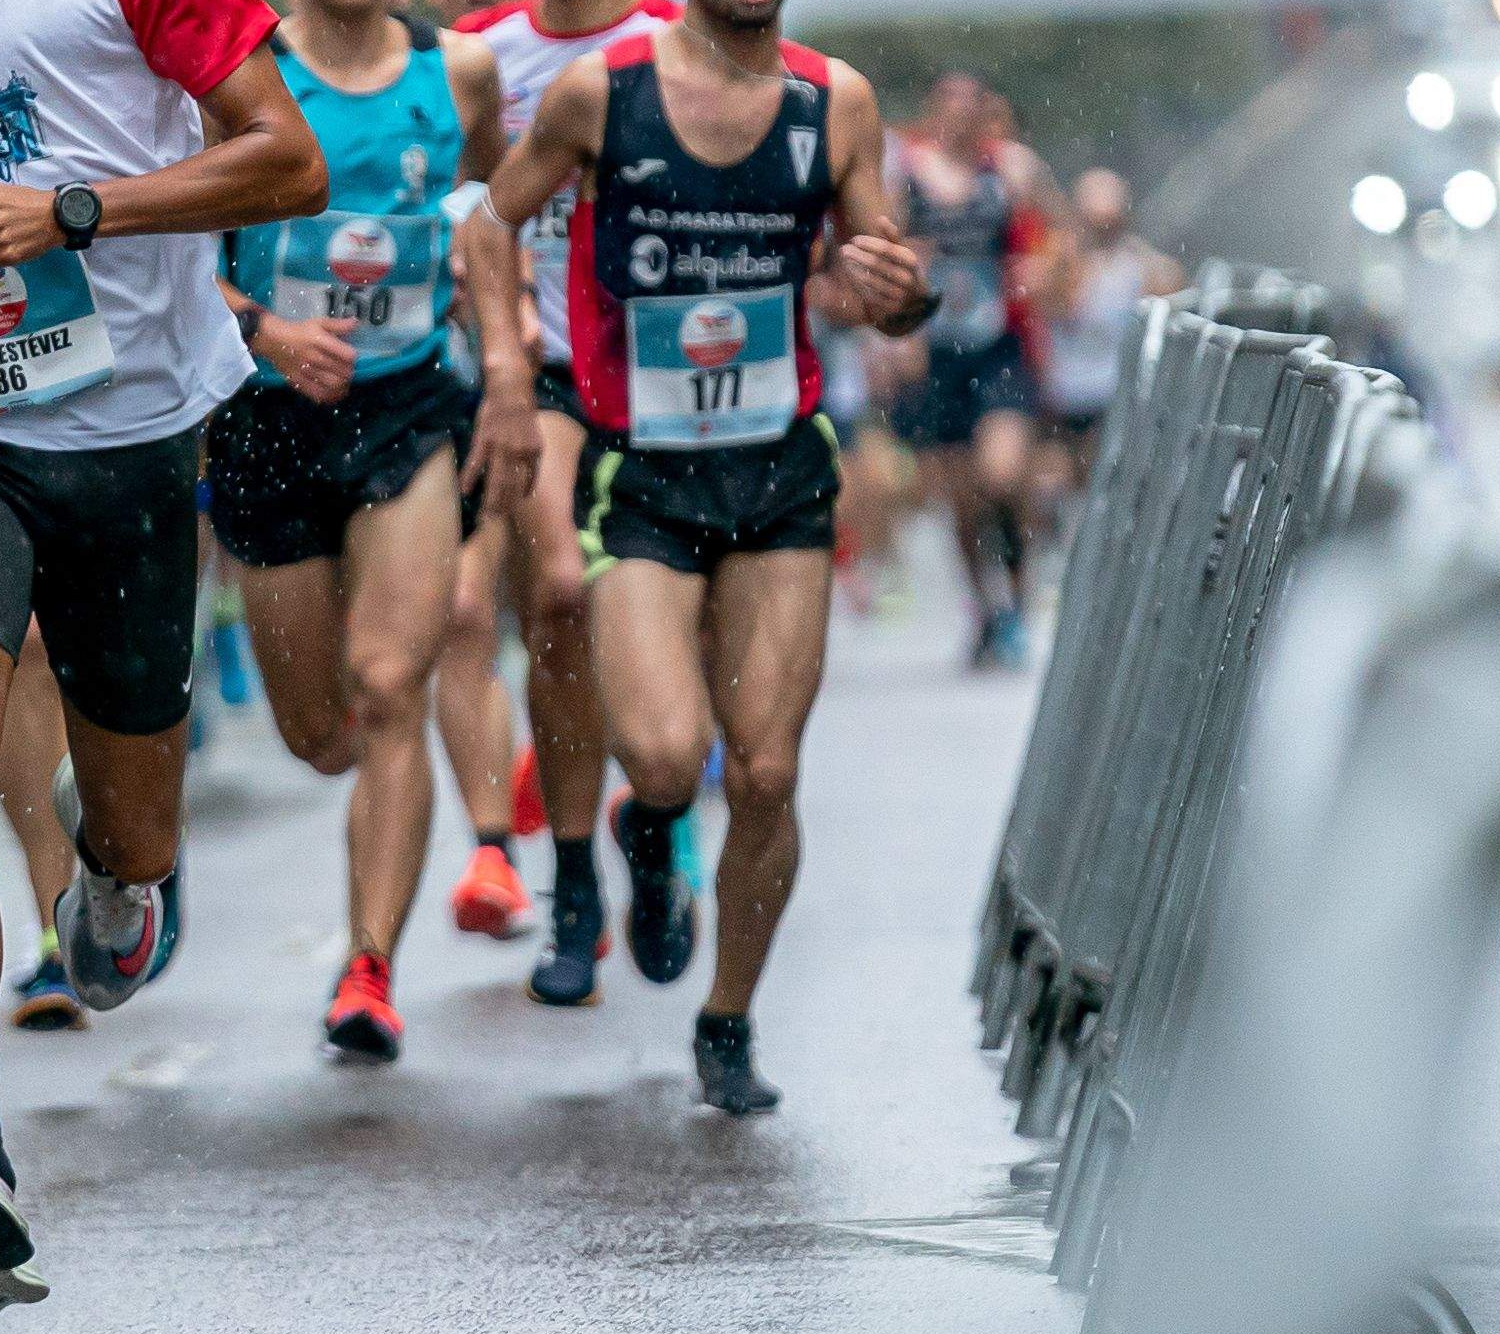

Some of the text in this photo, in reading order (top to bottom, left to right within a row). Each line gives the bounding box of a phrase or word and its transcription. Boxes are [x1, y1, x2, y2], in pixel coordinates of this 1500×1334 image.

[672, 243, 785, 292] alquiber
[325, 285, 392, 326] 150
[689, 366, 741, 411] 177
